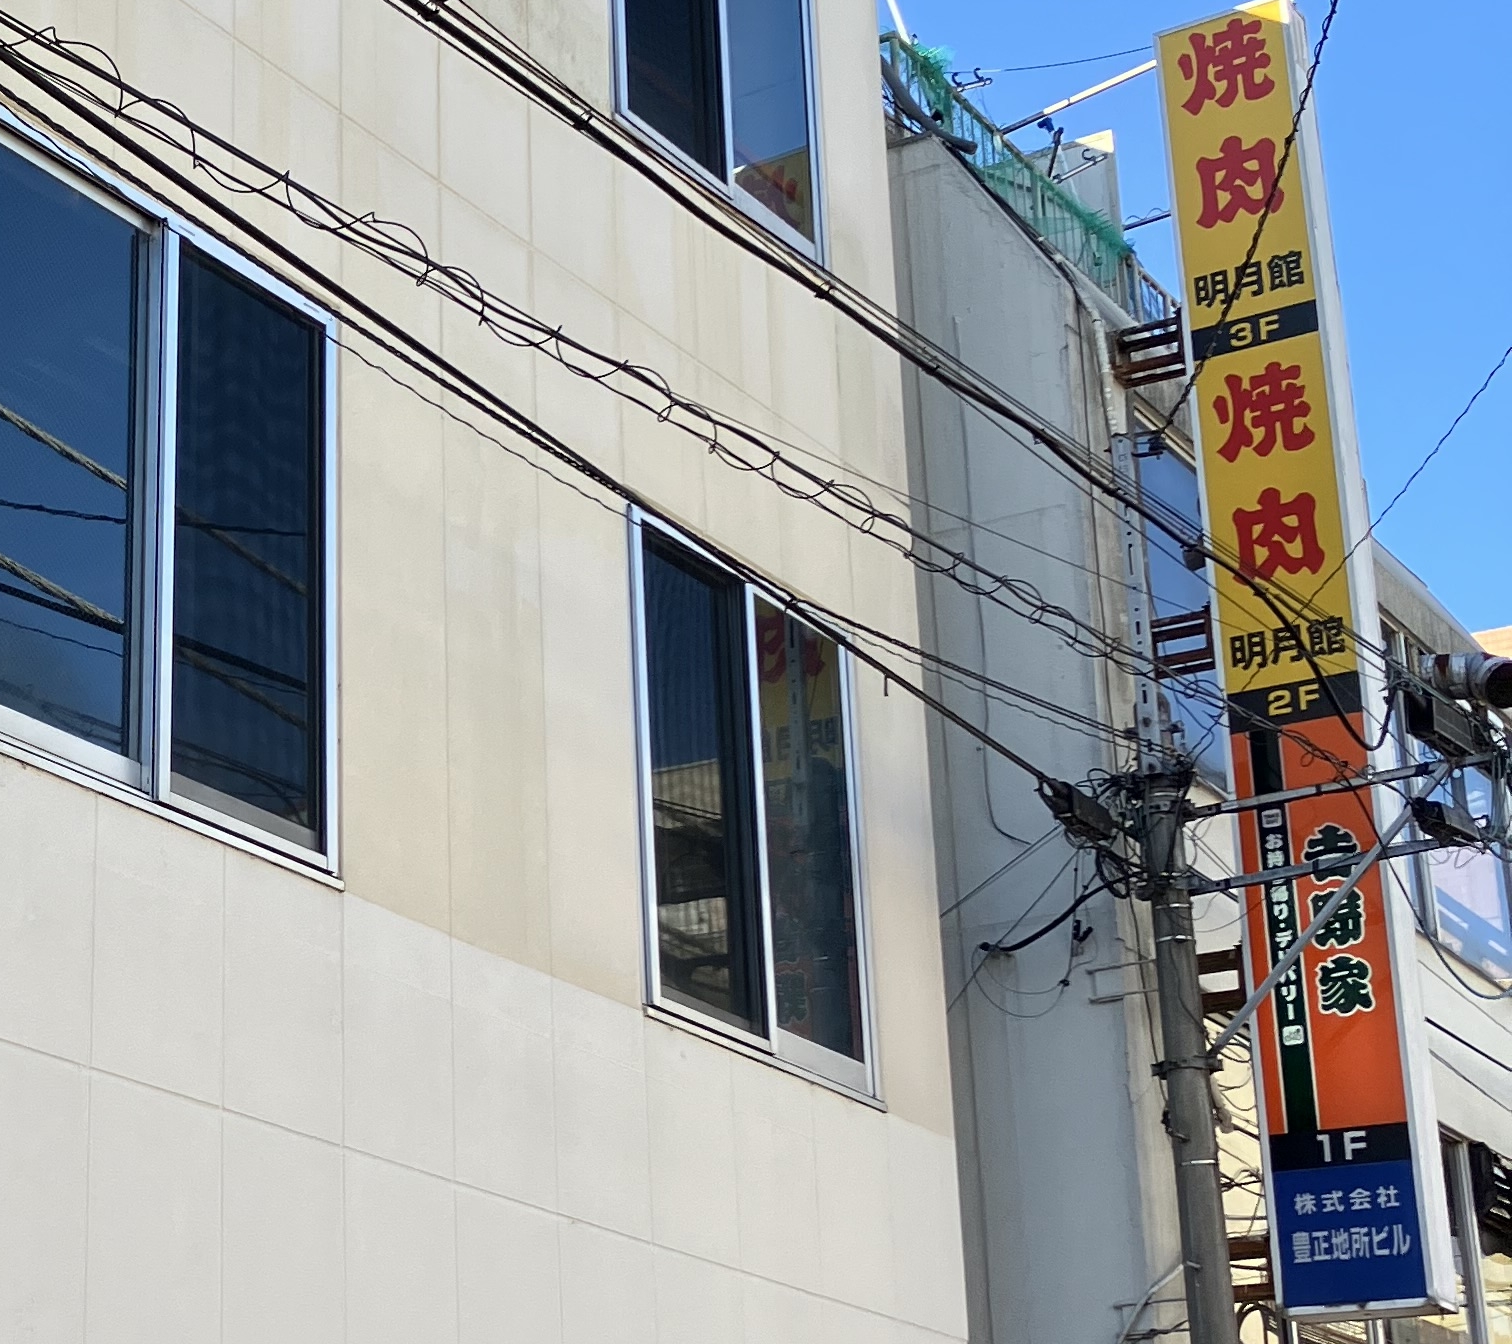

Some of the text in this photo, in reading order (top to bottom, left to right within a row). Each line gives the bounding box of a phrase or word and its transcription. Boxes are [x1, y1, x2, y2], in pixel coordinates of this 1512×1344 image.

[1178, 17, 1286, 230] 焼肉
[1193, 250, 1305, 309] 明月館
[1229, 314, 1280, 348] 3F
[1212, 360, 1326, 586] 焼肉
[1228, 615, 1346, 672] 明月館
[1266, 683, 1321, 717] 2F
[1316, 1130, 1368, 1163] 1F
[1293, 1184, 1401, 1216] 株式会社
[1291, 1223, 1411, 1264] 豊正地所ビル
